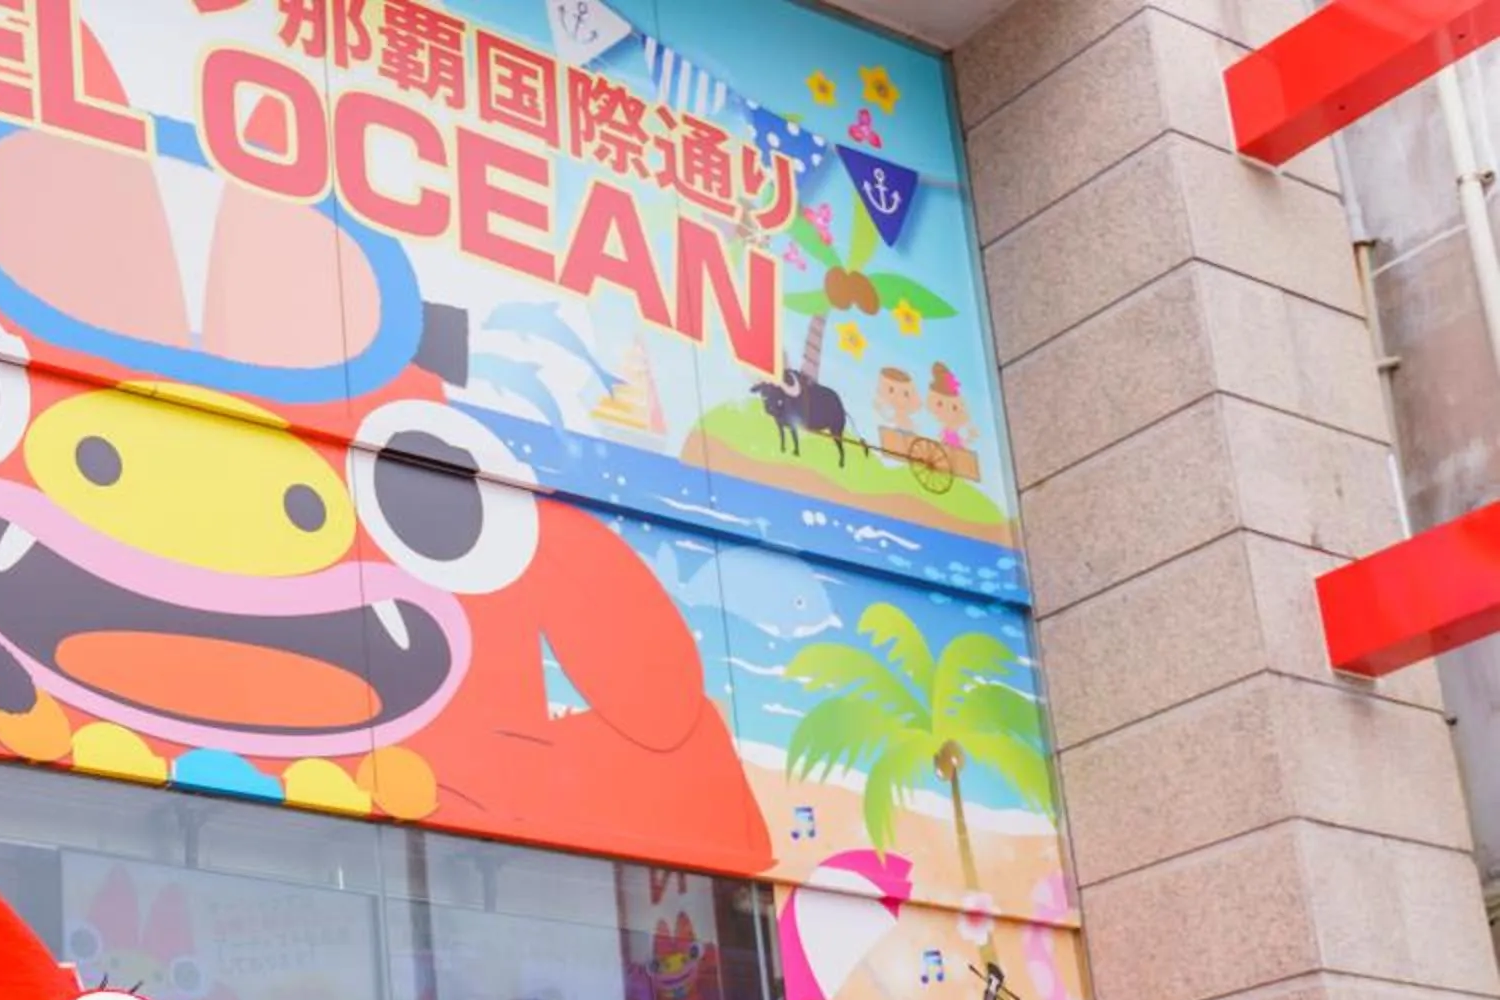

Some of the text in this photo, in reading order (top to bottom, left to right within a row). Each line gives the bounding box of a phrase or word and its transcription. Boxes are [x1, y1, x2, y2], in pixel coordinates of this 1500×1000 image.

[193, 0, 794, 230] 那覇国際通り
[201, 48, 776, 375] OCEAN
